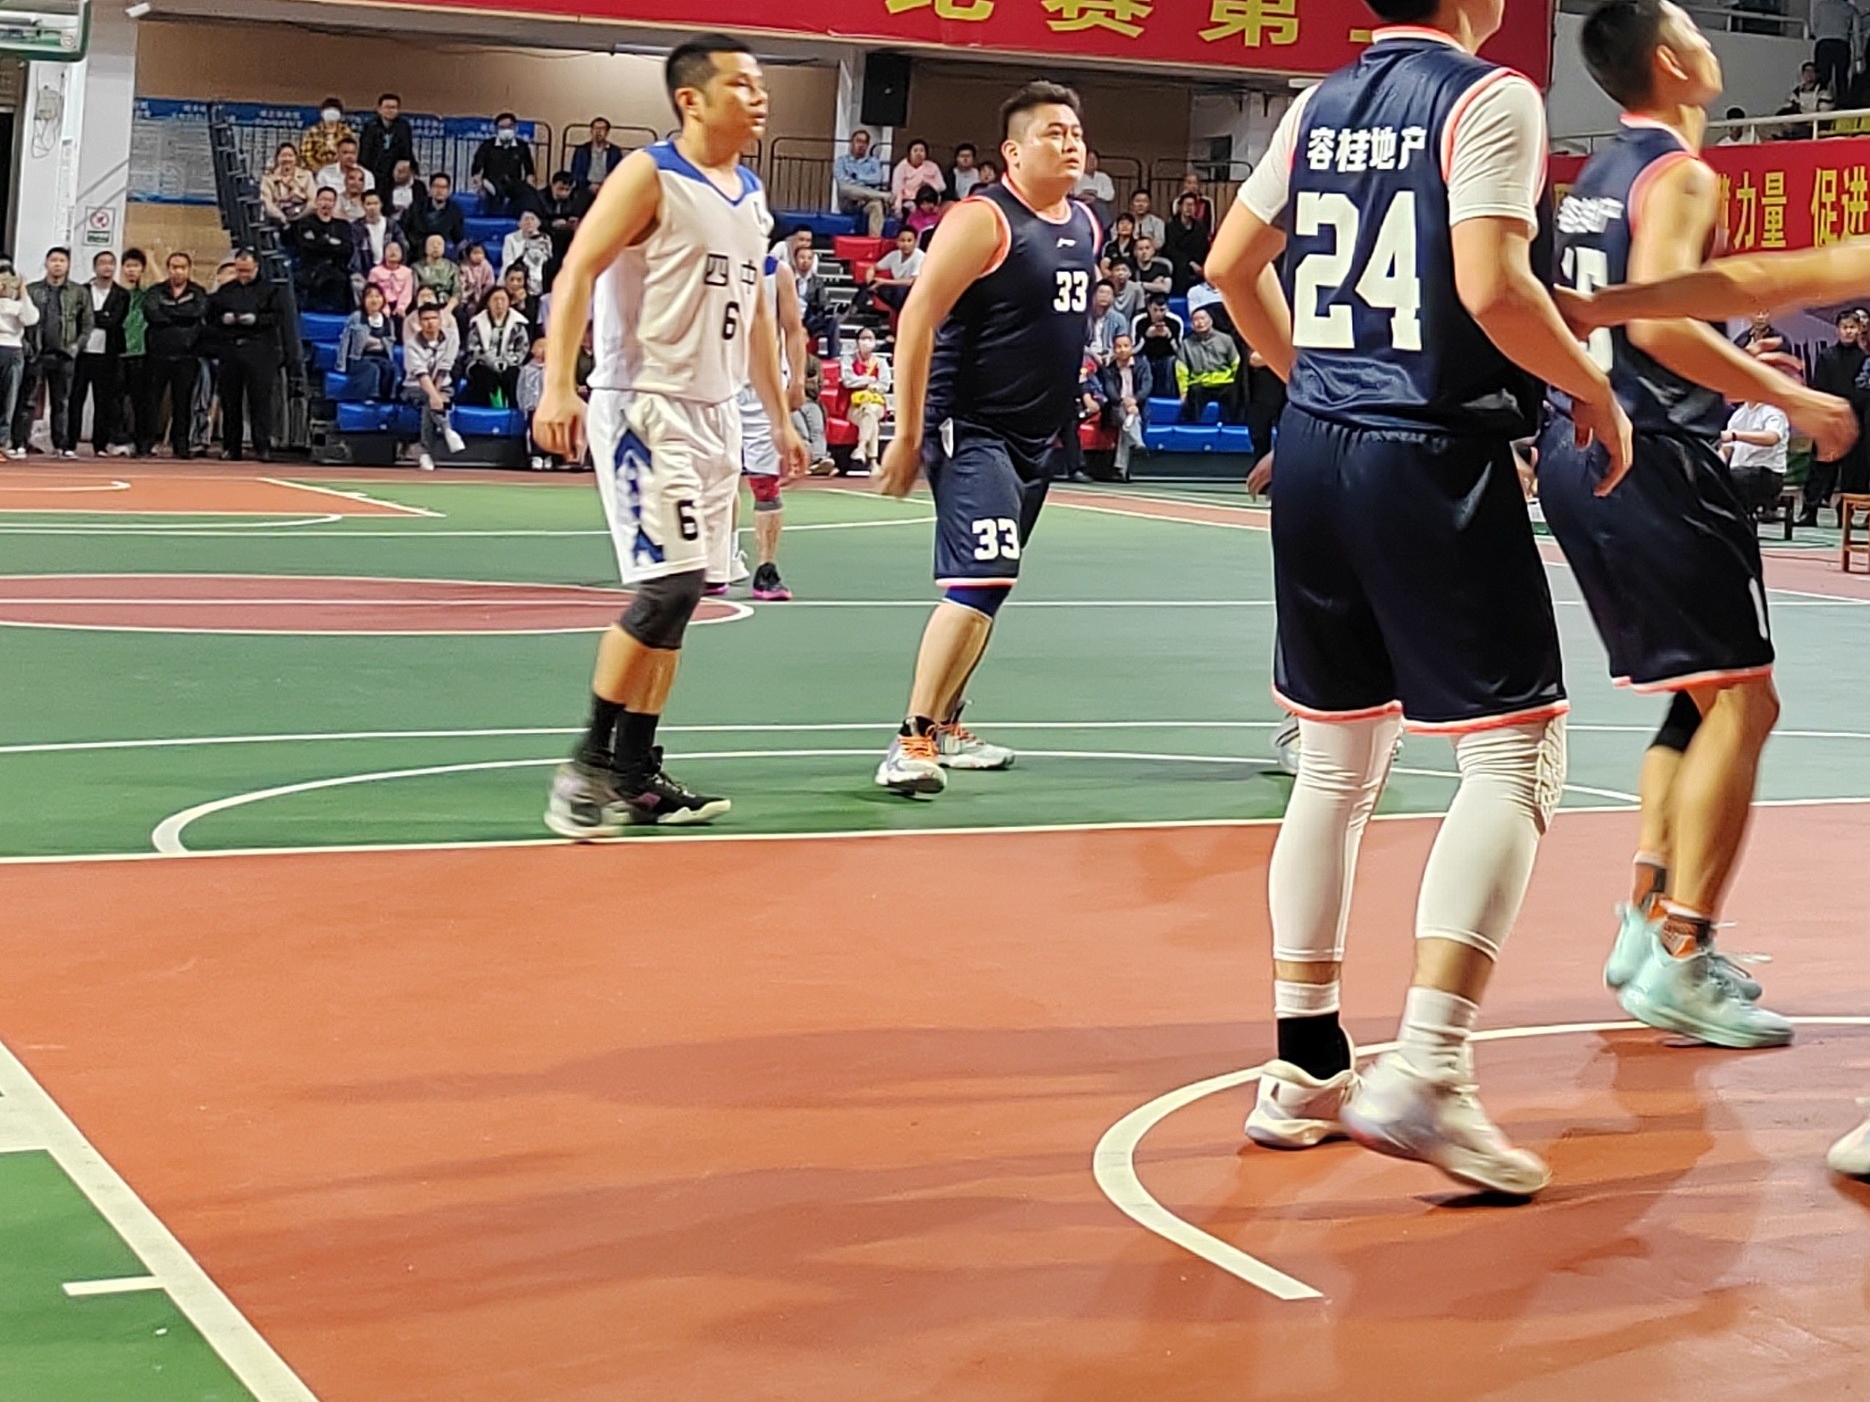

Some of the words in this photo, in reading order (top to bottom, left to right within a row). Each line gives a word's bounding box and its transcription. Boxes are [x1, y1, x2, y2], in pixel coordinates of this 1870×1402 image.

[1307, 126, 1428, 173] 容桂地产
[704, 253, 757, 295] 四中
[1053, 271, 1089, 312] 33
[1292, 191, 1423, 351] 24
[721, 302, 741, 340] 6
[680, 500, 698, 541] 6
[971, 517, 1022, 561] 33
